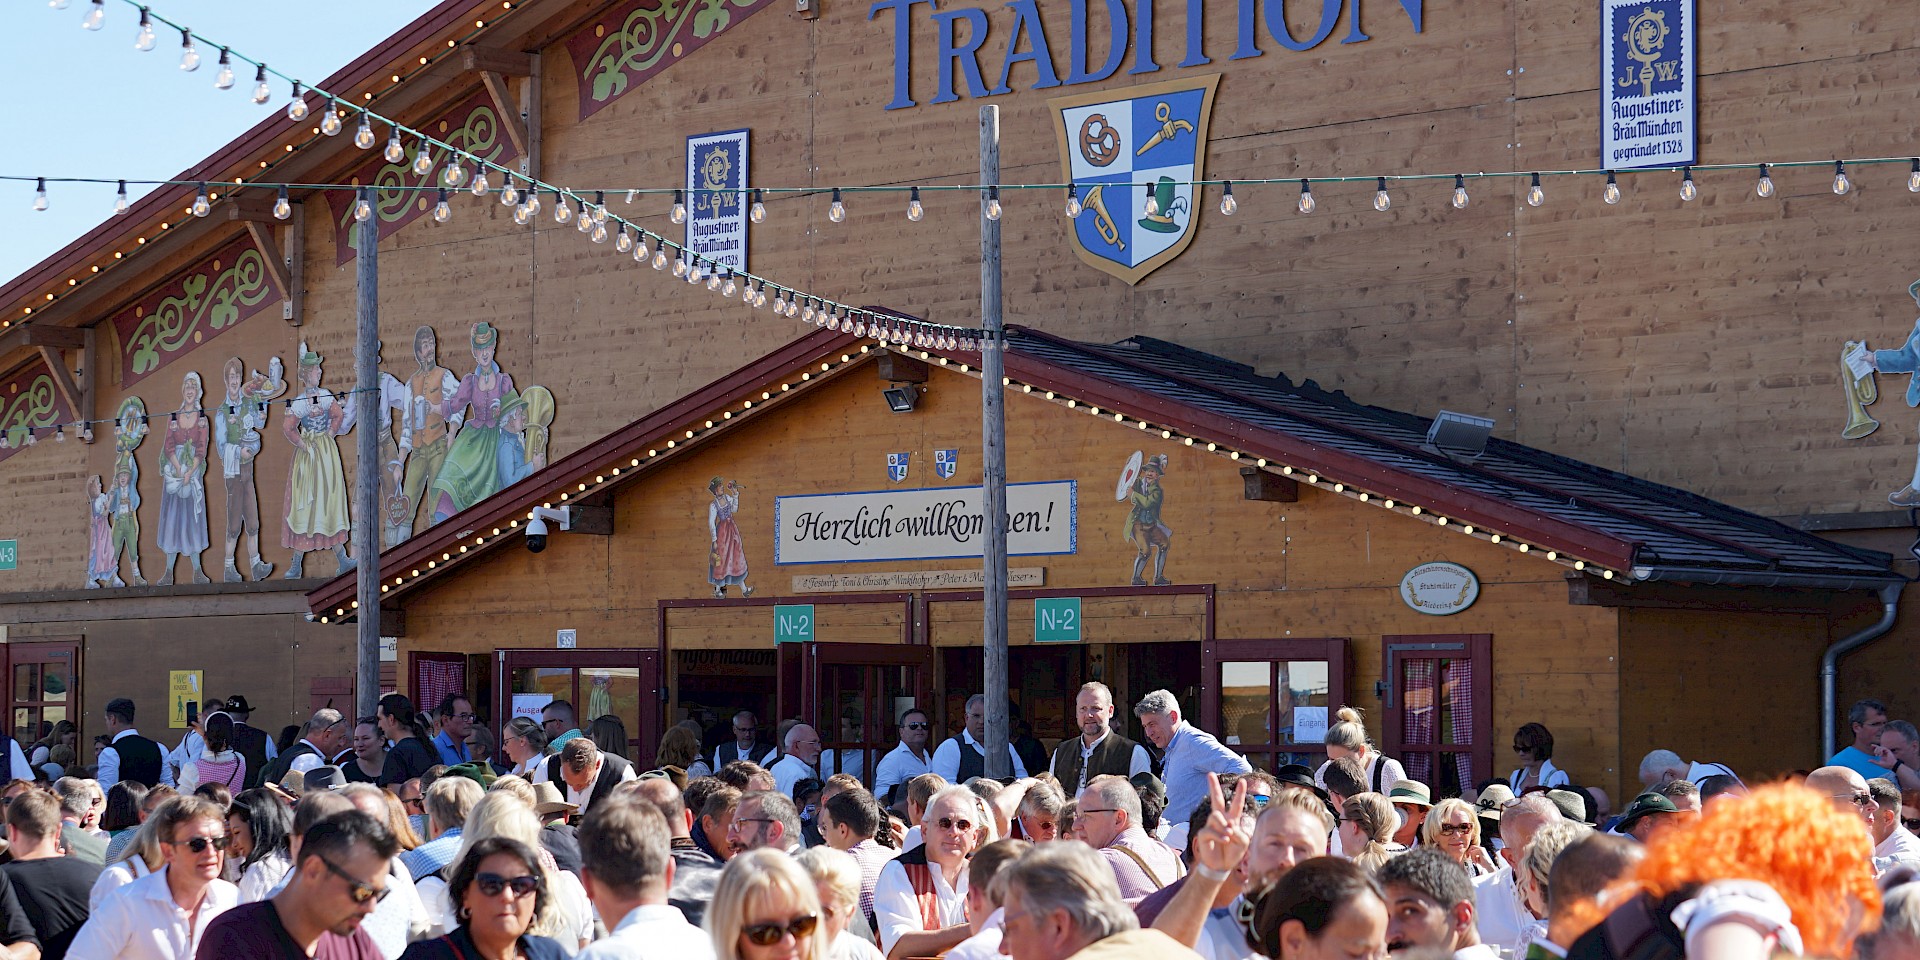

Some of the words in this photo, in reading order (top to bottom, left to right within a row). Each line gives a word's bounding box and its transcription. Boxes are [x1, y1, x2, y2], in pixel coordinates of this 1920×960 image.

[1613, 142, 1661, 162] gegründet
[1663, 139, 1683, 154] 1328
[725, 254, 739, 266] 1328
[794, 504, 893, 545] Herzlich
[895, 500, 1054, 543] willkomen!
[841, 575, 856, 587] Toni
[941, 572, 963, 586] Peter
[780, 615, 809, 635] N-2
[1041, 607, 1075, 631] N-2
[516, 706, 542, 715] Ausga
[1299, 719, 1326, 728] Eingang
